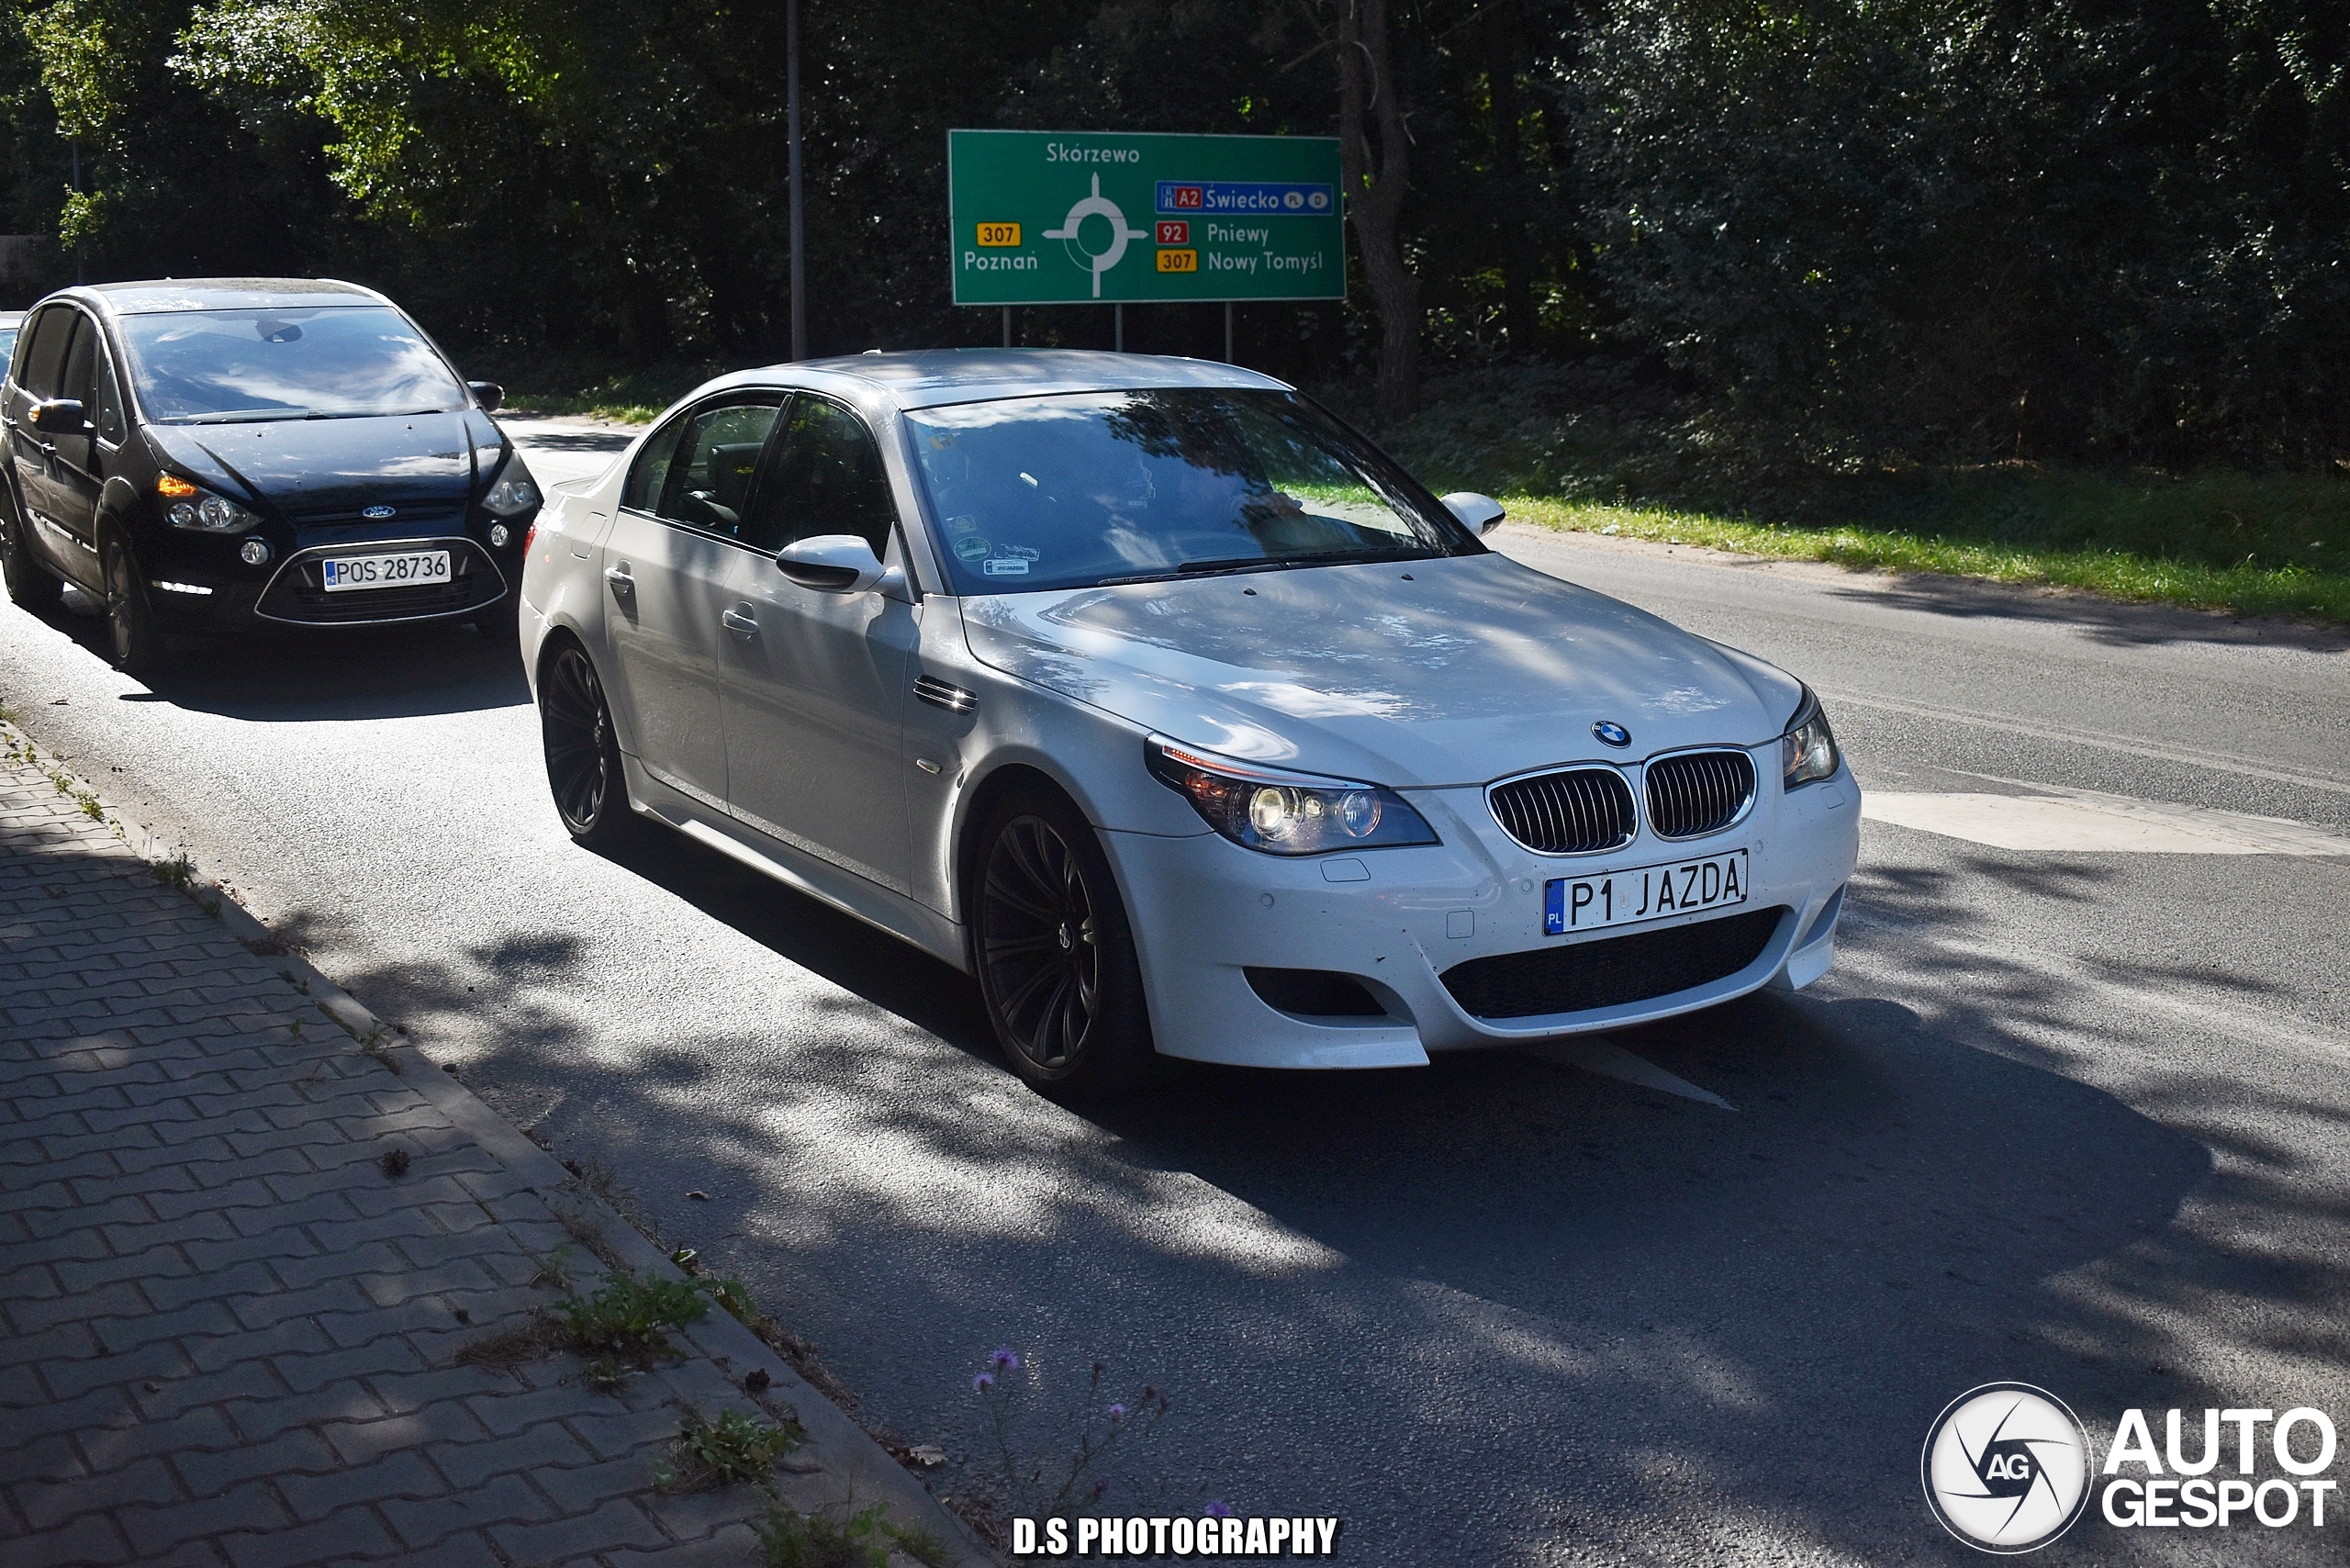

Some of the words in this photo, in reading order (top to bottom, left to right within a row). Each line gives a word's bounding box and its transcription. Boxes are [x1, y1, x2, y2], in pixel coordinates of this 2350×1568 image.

[1046, 143, 1140, 162] Skórzewo
[1180, 191, 1199, 207] A2
[1206, 185, 1279, 208] Świecko
[983, 227, 1013, 242] 307
[1163, 226, 1181, 241] 92
[1208, 223, 1270, 247] Pniewy
[964, 250, 1037, 270] Poznań
[1163, 253, 1191, 269] 307
[1208, 252, 1258, 274] Nowy
[1263, 251, 1323, 274] Tomyśl
[337, 561, 376, 583] POS
[385, 555, 445, 580] 28736
[1548, 913, 1562, 925] PL
[1571, 879, 1613, 925] P1
[1635, 857, 1740, 916] JAZDA
